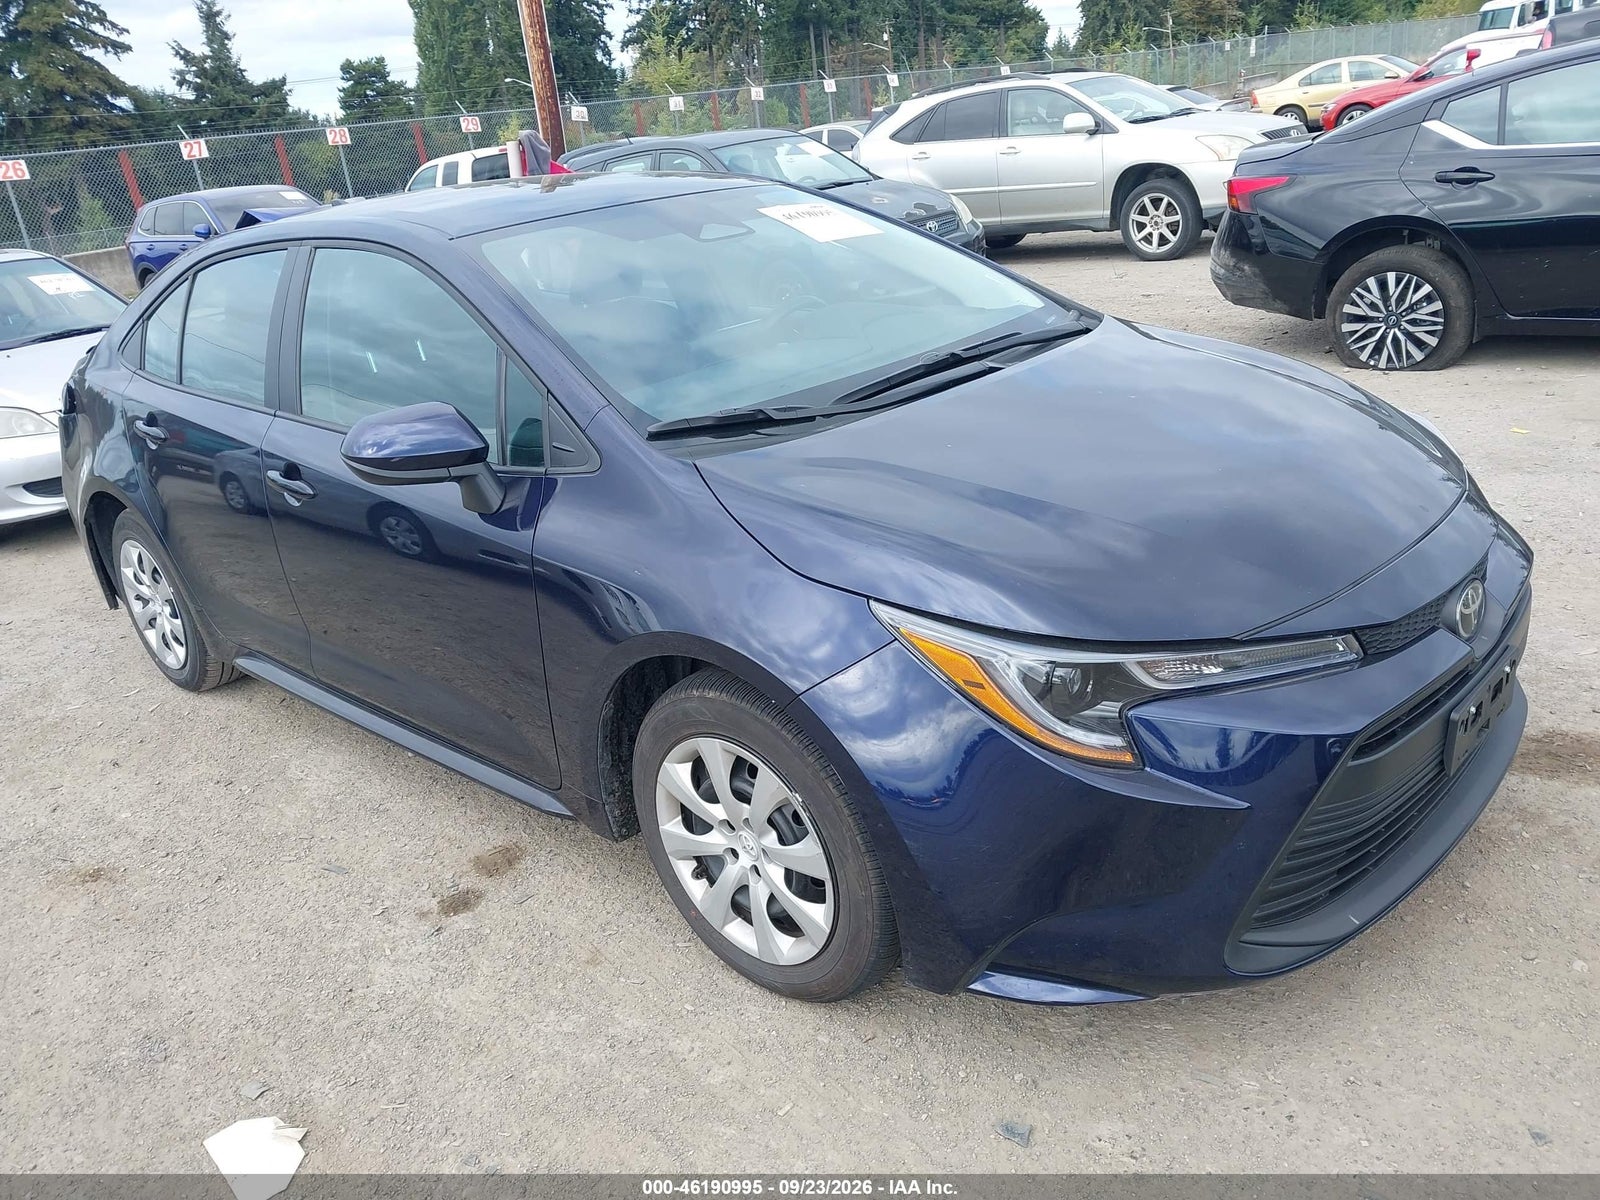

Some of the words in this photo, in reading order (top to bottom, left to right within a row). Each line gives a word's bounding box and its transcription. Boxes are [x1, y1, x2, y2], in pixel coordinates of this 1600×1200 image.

[462, 117, 479, 131] 29
[329, 128, 348, 144] 28
[183, 140, 203, 158] 27
[0, 161, 26, 179] 26
